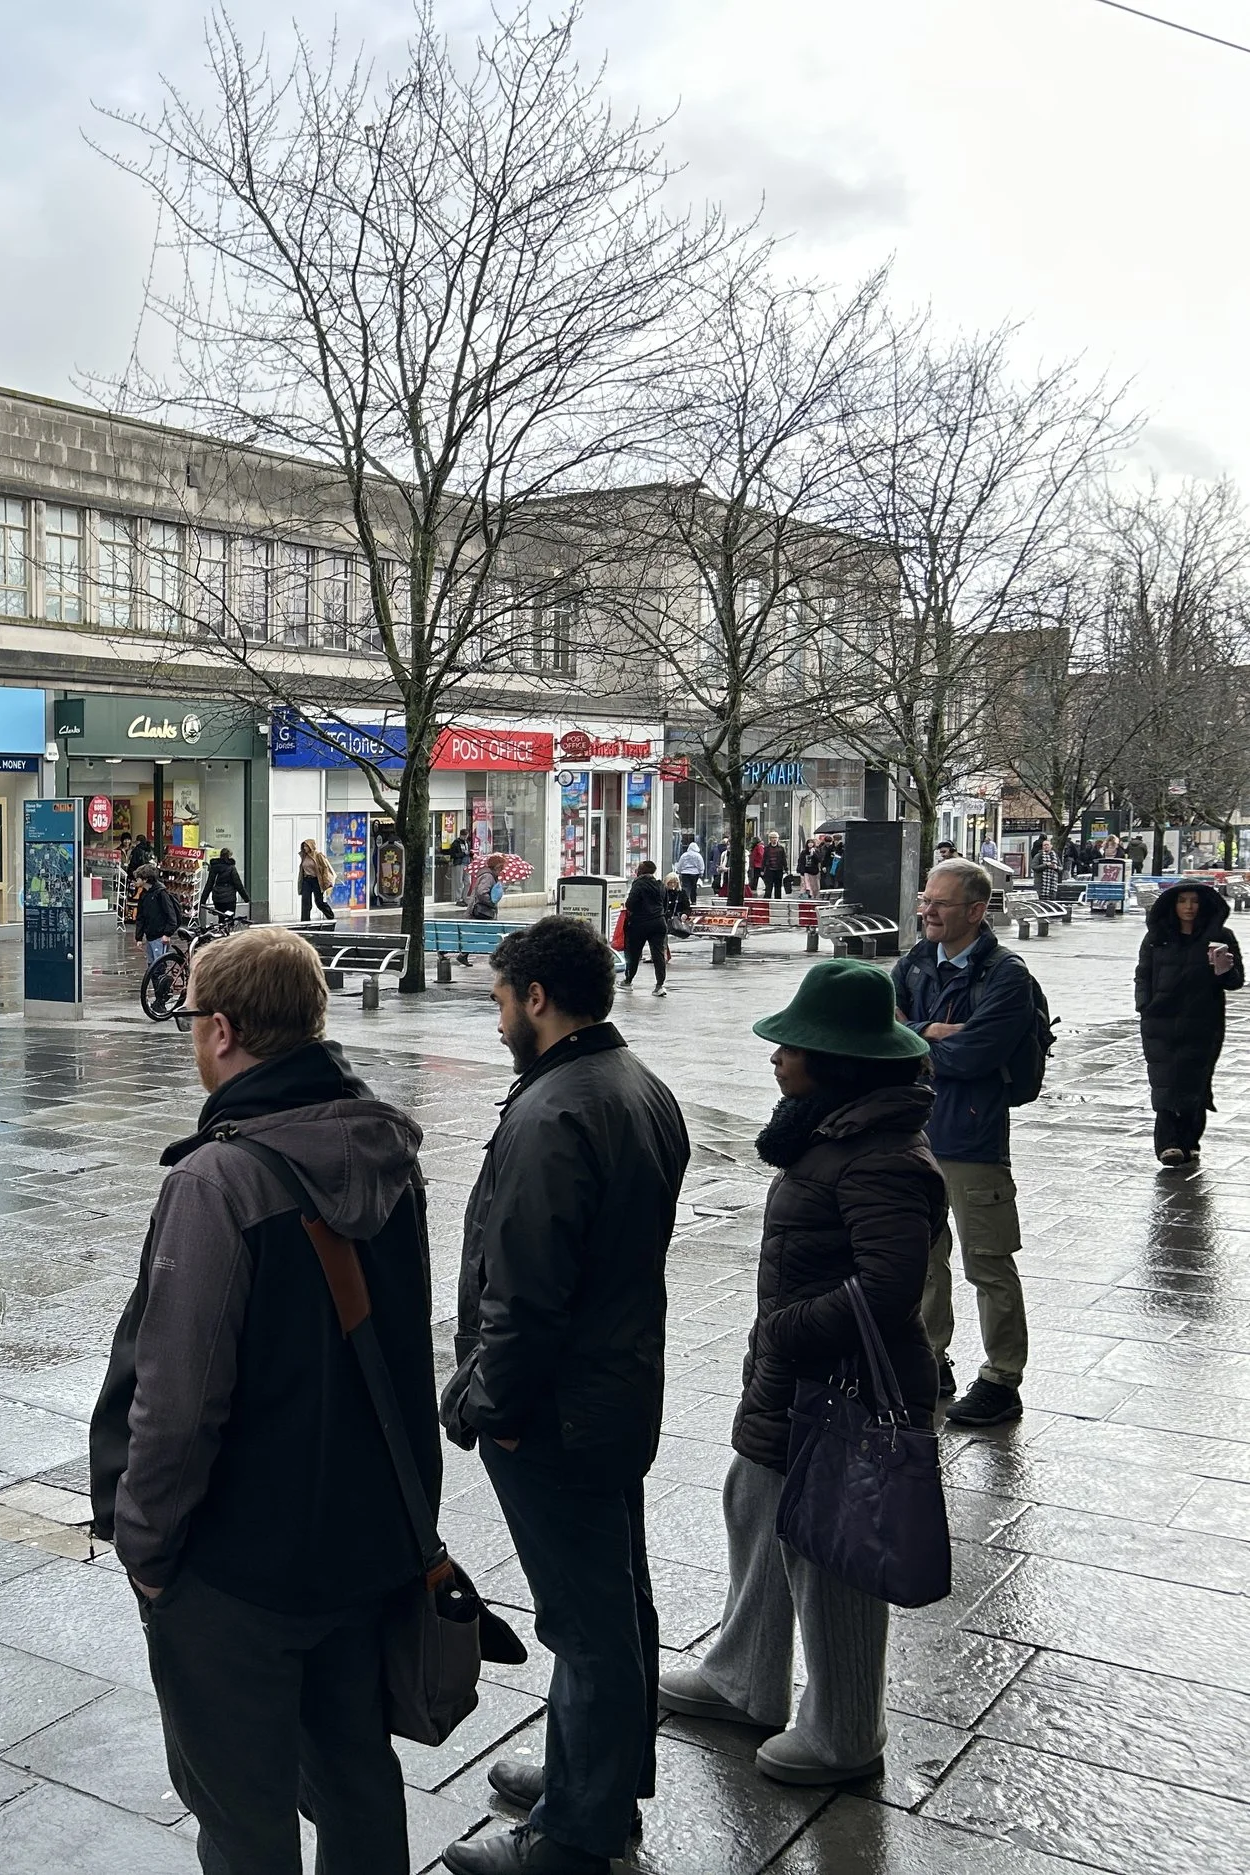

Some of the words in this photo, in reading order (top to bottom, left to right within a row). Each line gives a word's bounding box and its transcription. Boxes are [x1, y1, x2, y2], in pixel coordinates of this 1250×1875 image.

[58, 725, 81, 735] Clarks
[127, 714, 178, 739] Clarks
[452, 738, 487, 760] POST
[488, 740, 533, 761] OFFICE
[2, 759, 27, 770] MONEY
[742, 761, 805, 785] PRIMARK
[188, 849, 201, 858] £20
